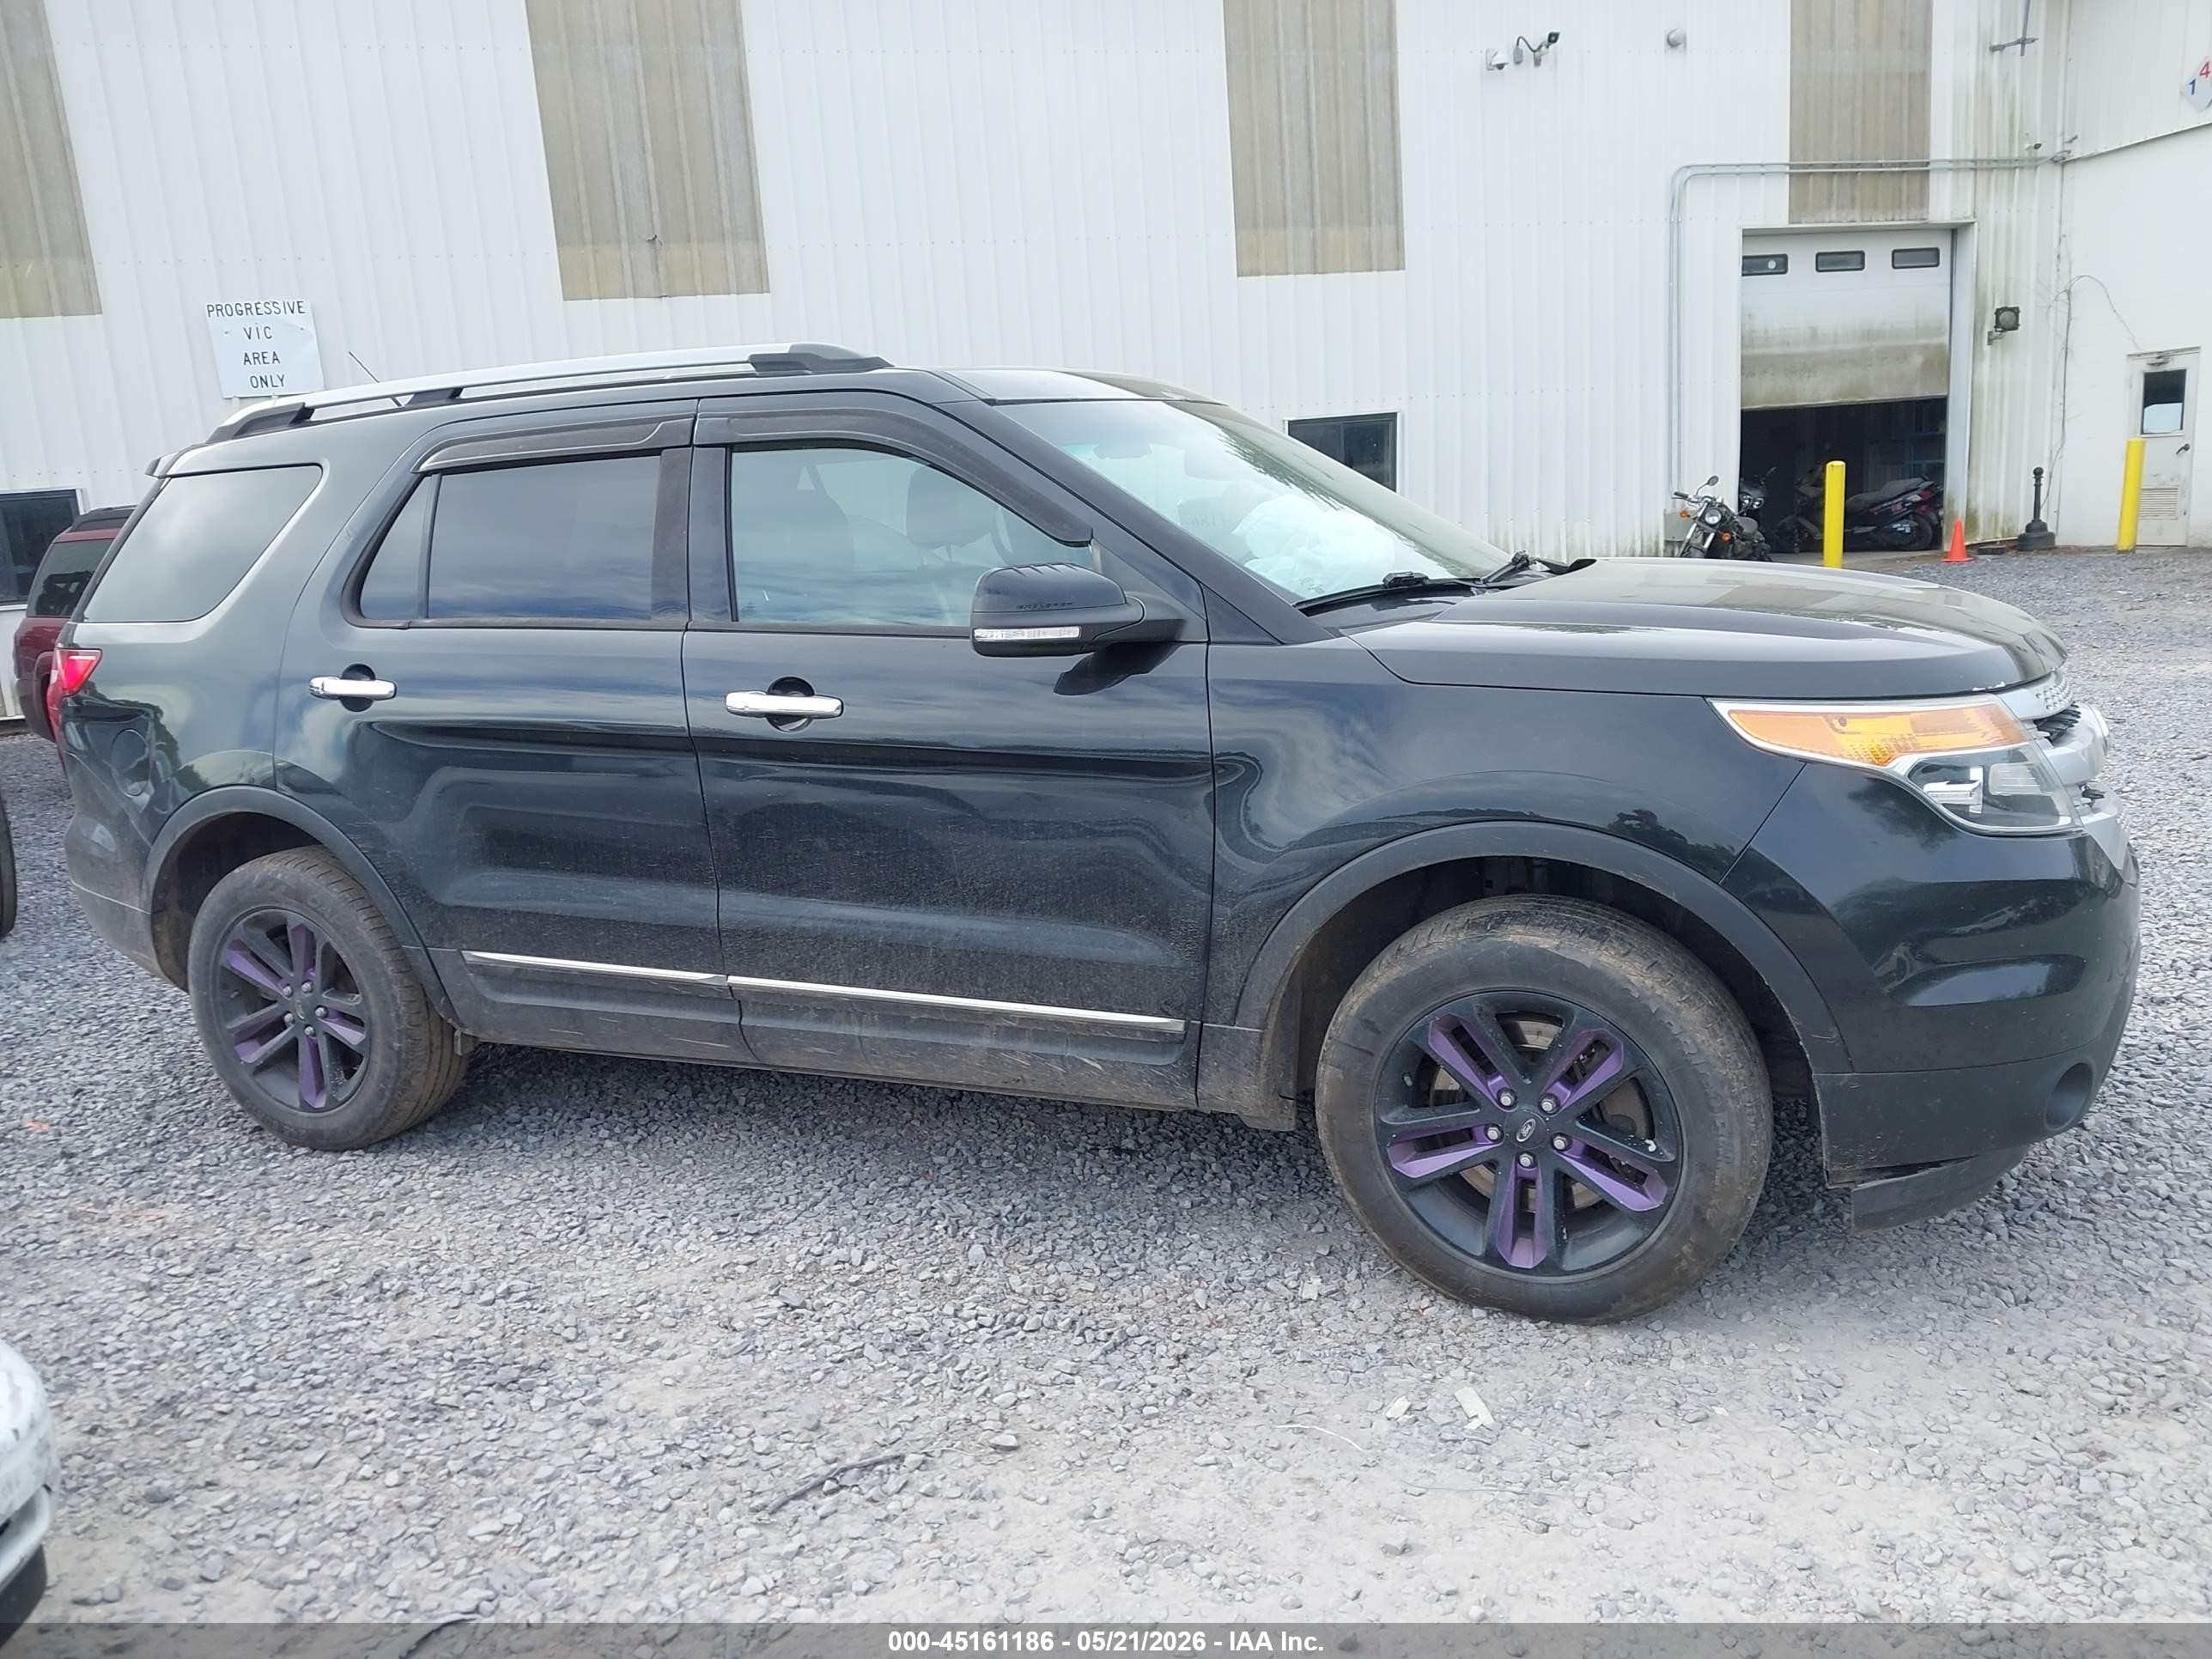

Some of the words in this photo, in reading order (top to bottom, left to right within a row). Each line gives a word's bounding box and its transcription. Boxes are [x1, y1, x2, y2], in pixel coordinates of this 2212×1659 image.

[2199, 61, 2211, 78] 4
[2188, 78, 2197, 95] 1
[206, 301, 306, 318] PROGRESSIVE
[243, 325, 273, 340] VIC
[243, 350, 281, 366] AREA
[249, 374, 285, 388] ONLY
